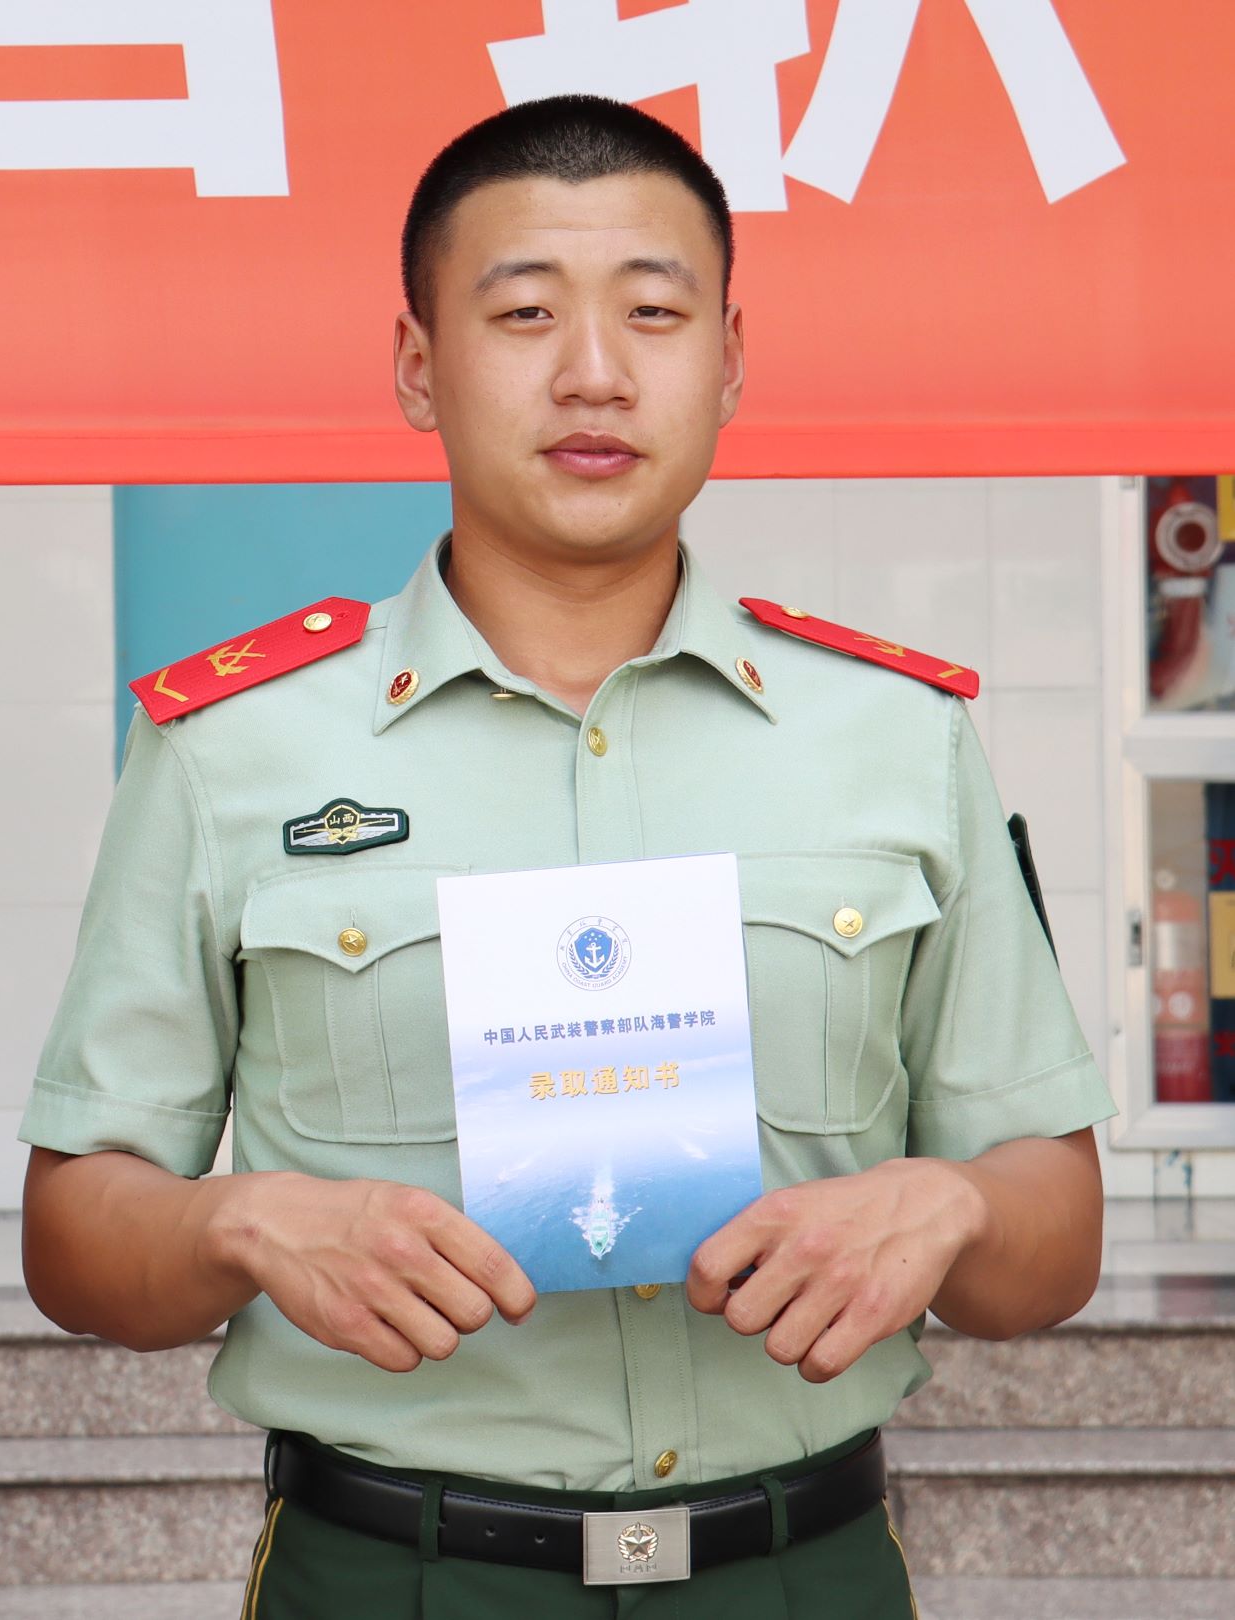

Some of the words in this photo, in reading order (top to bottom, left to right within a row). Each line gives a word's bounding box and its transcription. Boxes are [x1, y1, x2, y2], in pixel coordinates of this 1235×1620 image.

[329, 813, 354, 826] 山西
[483, 1010, 716, 1046] 中国人民武装警察部队海警学院
[528, 1060, 680, 1100] 录取通知书
